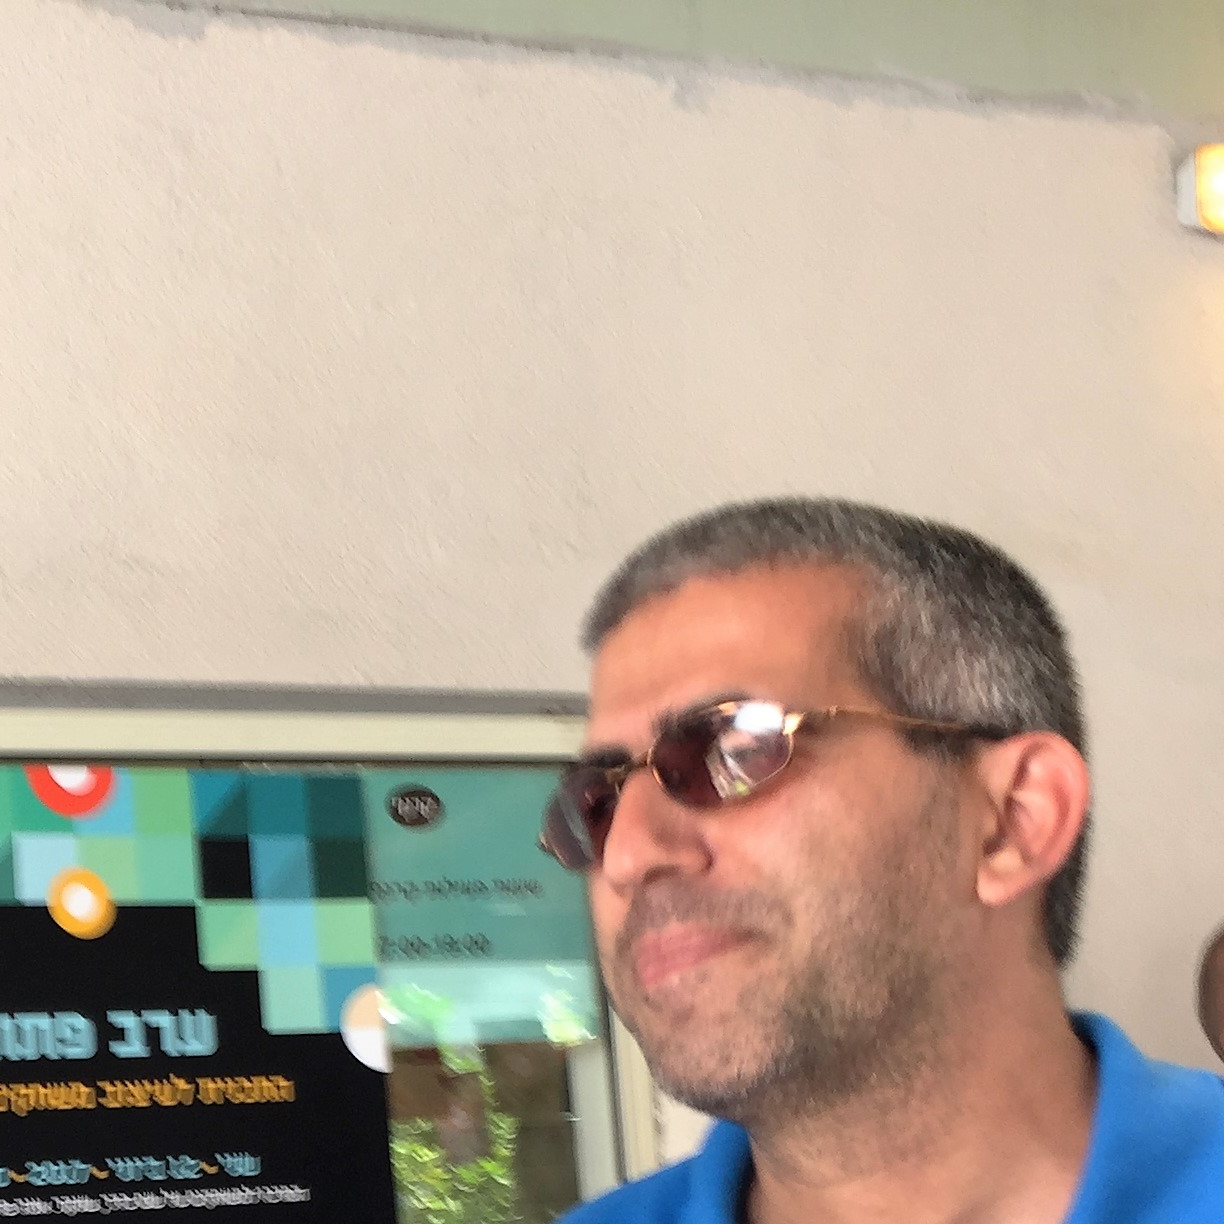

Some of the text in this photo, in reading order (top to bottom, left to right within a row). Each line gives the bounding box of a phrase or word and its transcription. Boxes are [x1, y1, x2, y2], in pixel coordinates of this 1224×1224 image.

[107, 1008, 219, 1059] ערב
[96, 1073, 194, 1109] לעיצוב
[26, 1159, 92, 1187] 2017
